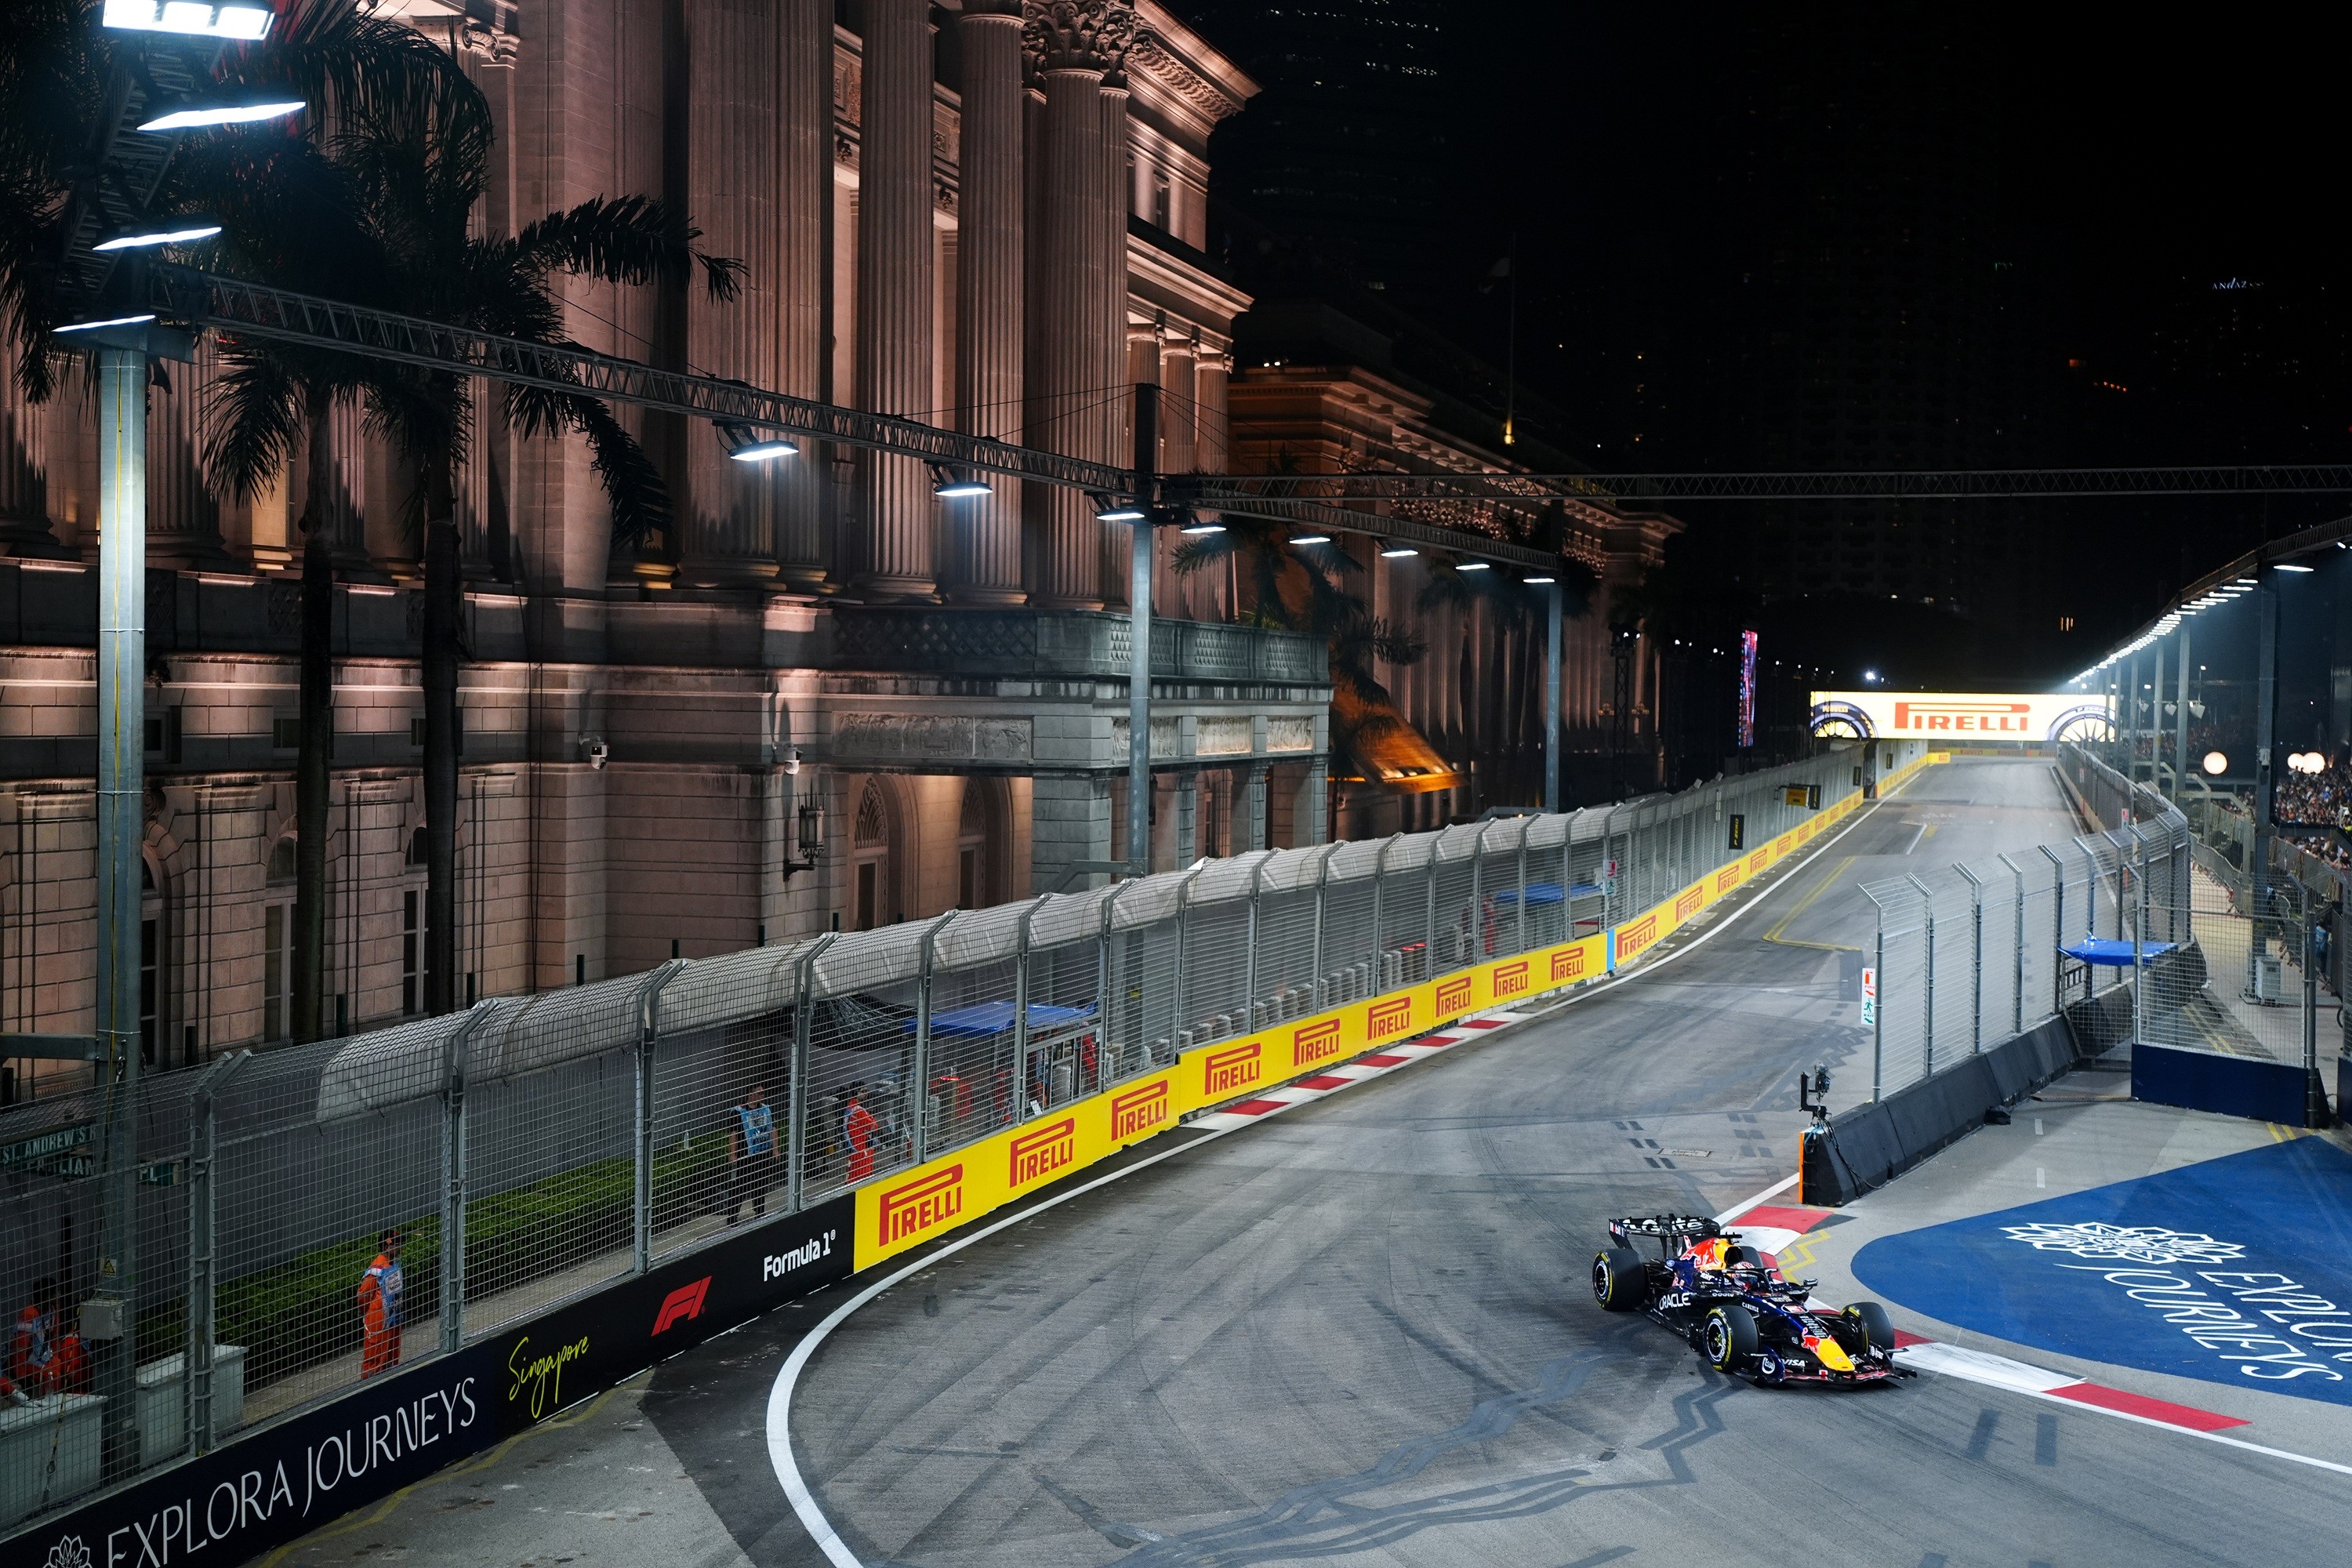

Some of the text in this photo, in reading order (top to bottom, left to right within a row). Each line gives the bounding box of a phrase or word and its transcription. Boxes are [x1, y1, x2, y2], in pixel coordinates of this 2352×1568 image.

[1894, 702, 2031, 731] PIRELLI
[1750, 848, 1767, 873] PIRELLI
[1777, 836, 1791, 857] PIRELLI
[1718, 865, 1739, 893] PIRELLI
[1676, 885, 1703, 923] PIRELLI
[1617, 915, 1656, 958] PIRELLI
[1494, 961, 1528, 997] PIRELLI
[1552, 947, 1584, 981] PIRELLI
[1368, 996, 1410, 1040] PIRELLI
[1436, 976, 1471, 1018] PIRELLI
[1294, 1018, 1340, 1066] PIRELLI
[1205, 1043, 1261, 1095] PIRELLI
[1112, 1080, 1168, 1142] PIRELLI
[1010, 1117, 1075, 1188] PIRELLI
[879, 1163, 963, 1247] PIRELLI
[764, 1238, 820, 1282] Formula
[651, 1275, 713, 1338] F1
[1659, 1292, 1692, 1311] ORACLE
[1741, 1302, 1760, 1313] CARLYLE
[2053, 1263, 2343, 1381] JOURNEYS
[509, 1336, 590, 1419] Singapore
[1783, 1359, 1806, 1367] VISA
[107, 1377, 476, 1568] EXPLORA JOURNEYS
